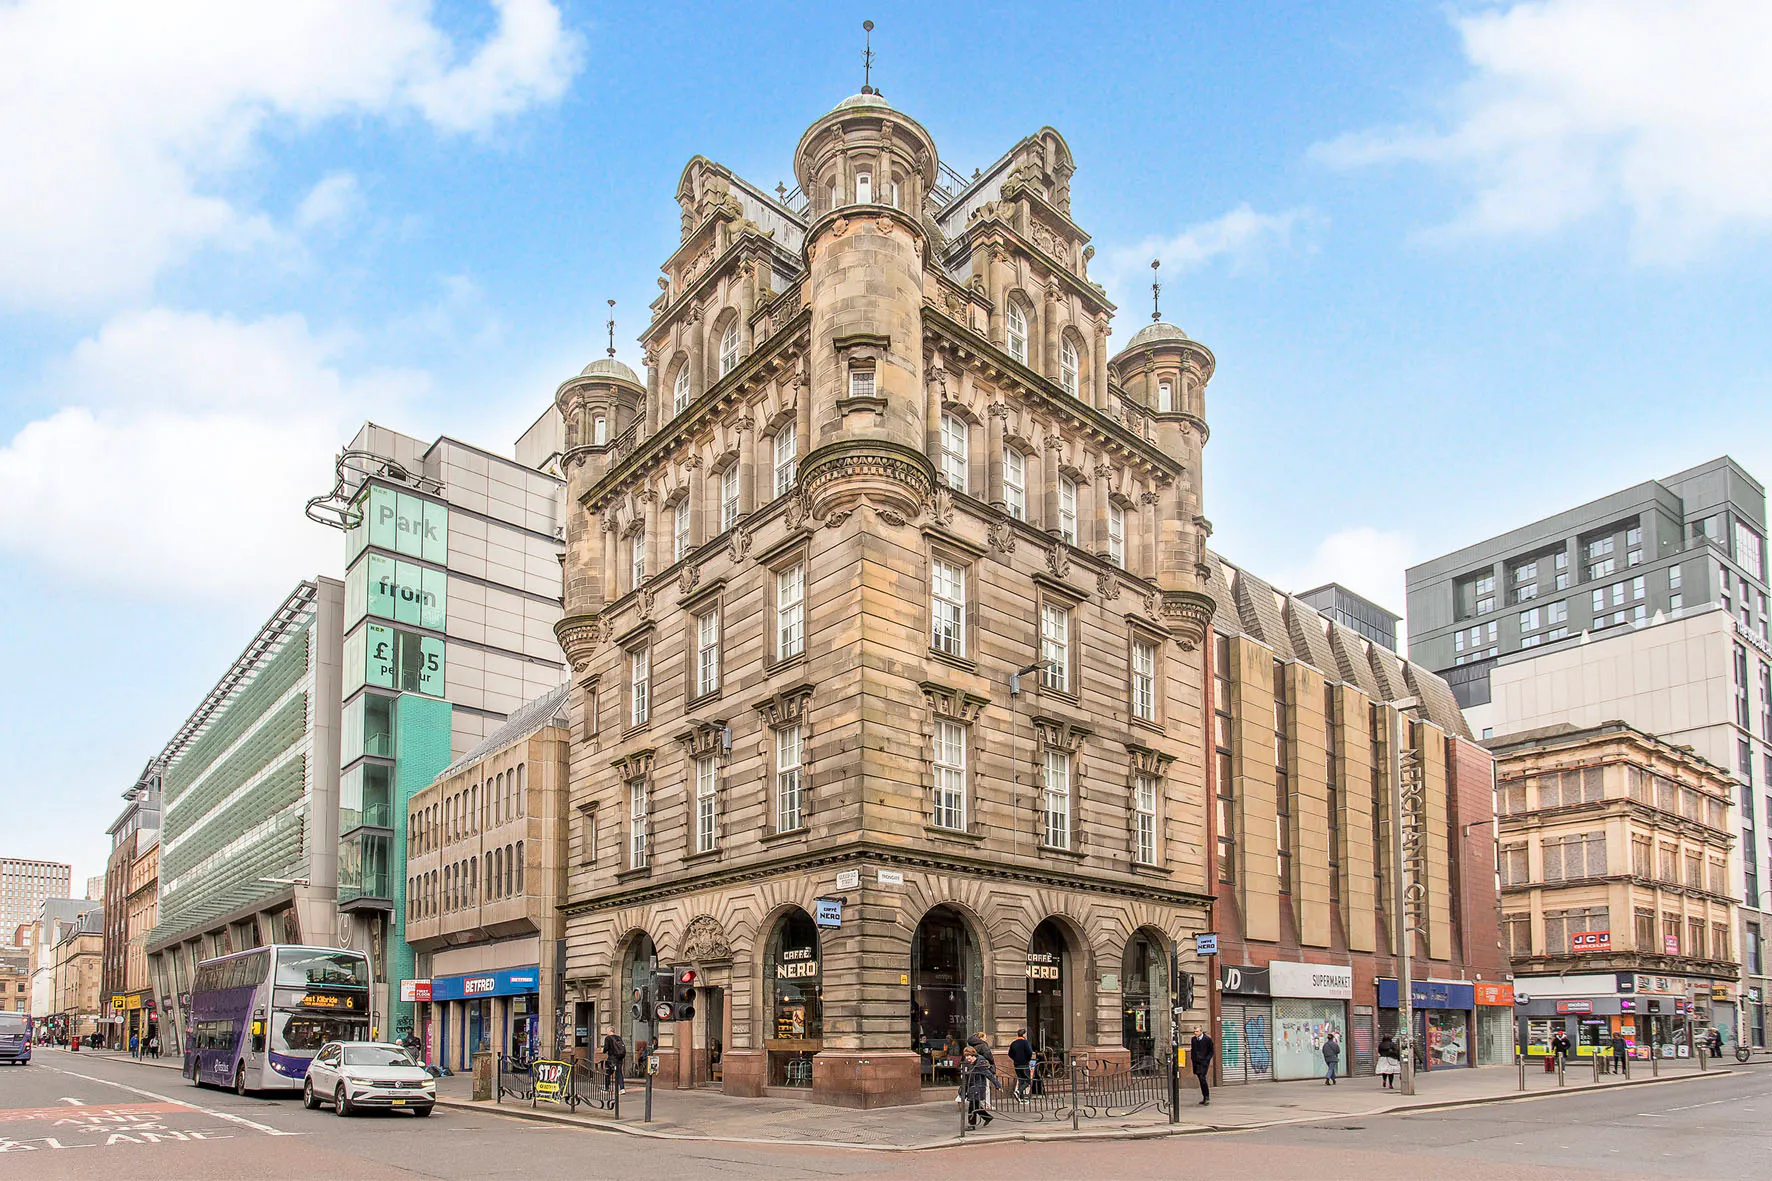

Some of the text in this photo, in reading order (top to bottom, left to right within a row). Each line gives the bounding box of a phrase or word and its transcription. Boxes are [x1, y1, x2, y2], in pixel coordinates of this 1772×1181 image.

[379, 504, 438, 541] Park
[379, 575, 436, 608] from
[1400, 748, 1427, 934] MERCHANT CITY
[1574, 934, 1609, 944] JCJ
[777, 961, 816, 979] NERO
[1225, 968, 1241, 990] JD
[465, 978, 495, 993] BETFRED
[1312, 974, 1351, 988] SUPERMARKET
[346, 997, 353, 1008] 6
[538, 1064, 562, 1081] STOP
[46, 1130, 235, 1149] LANE
